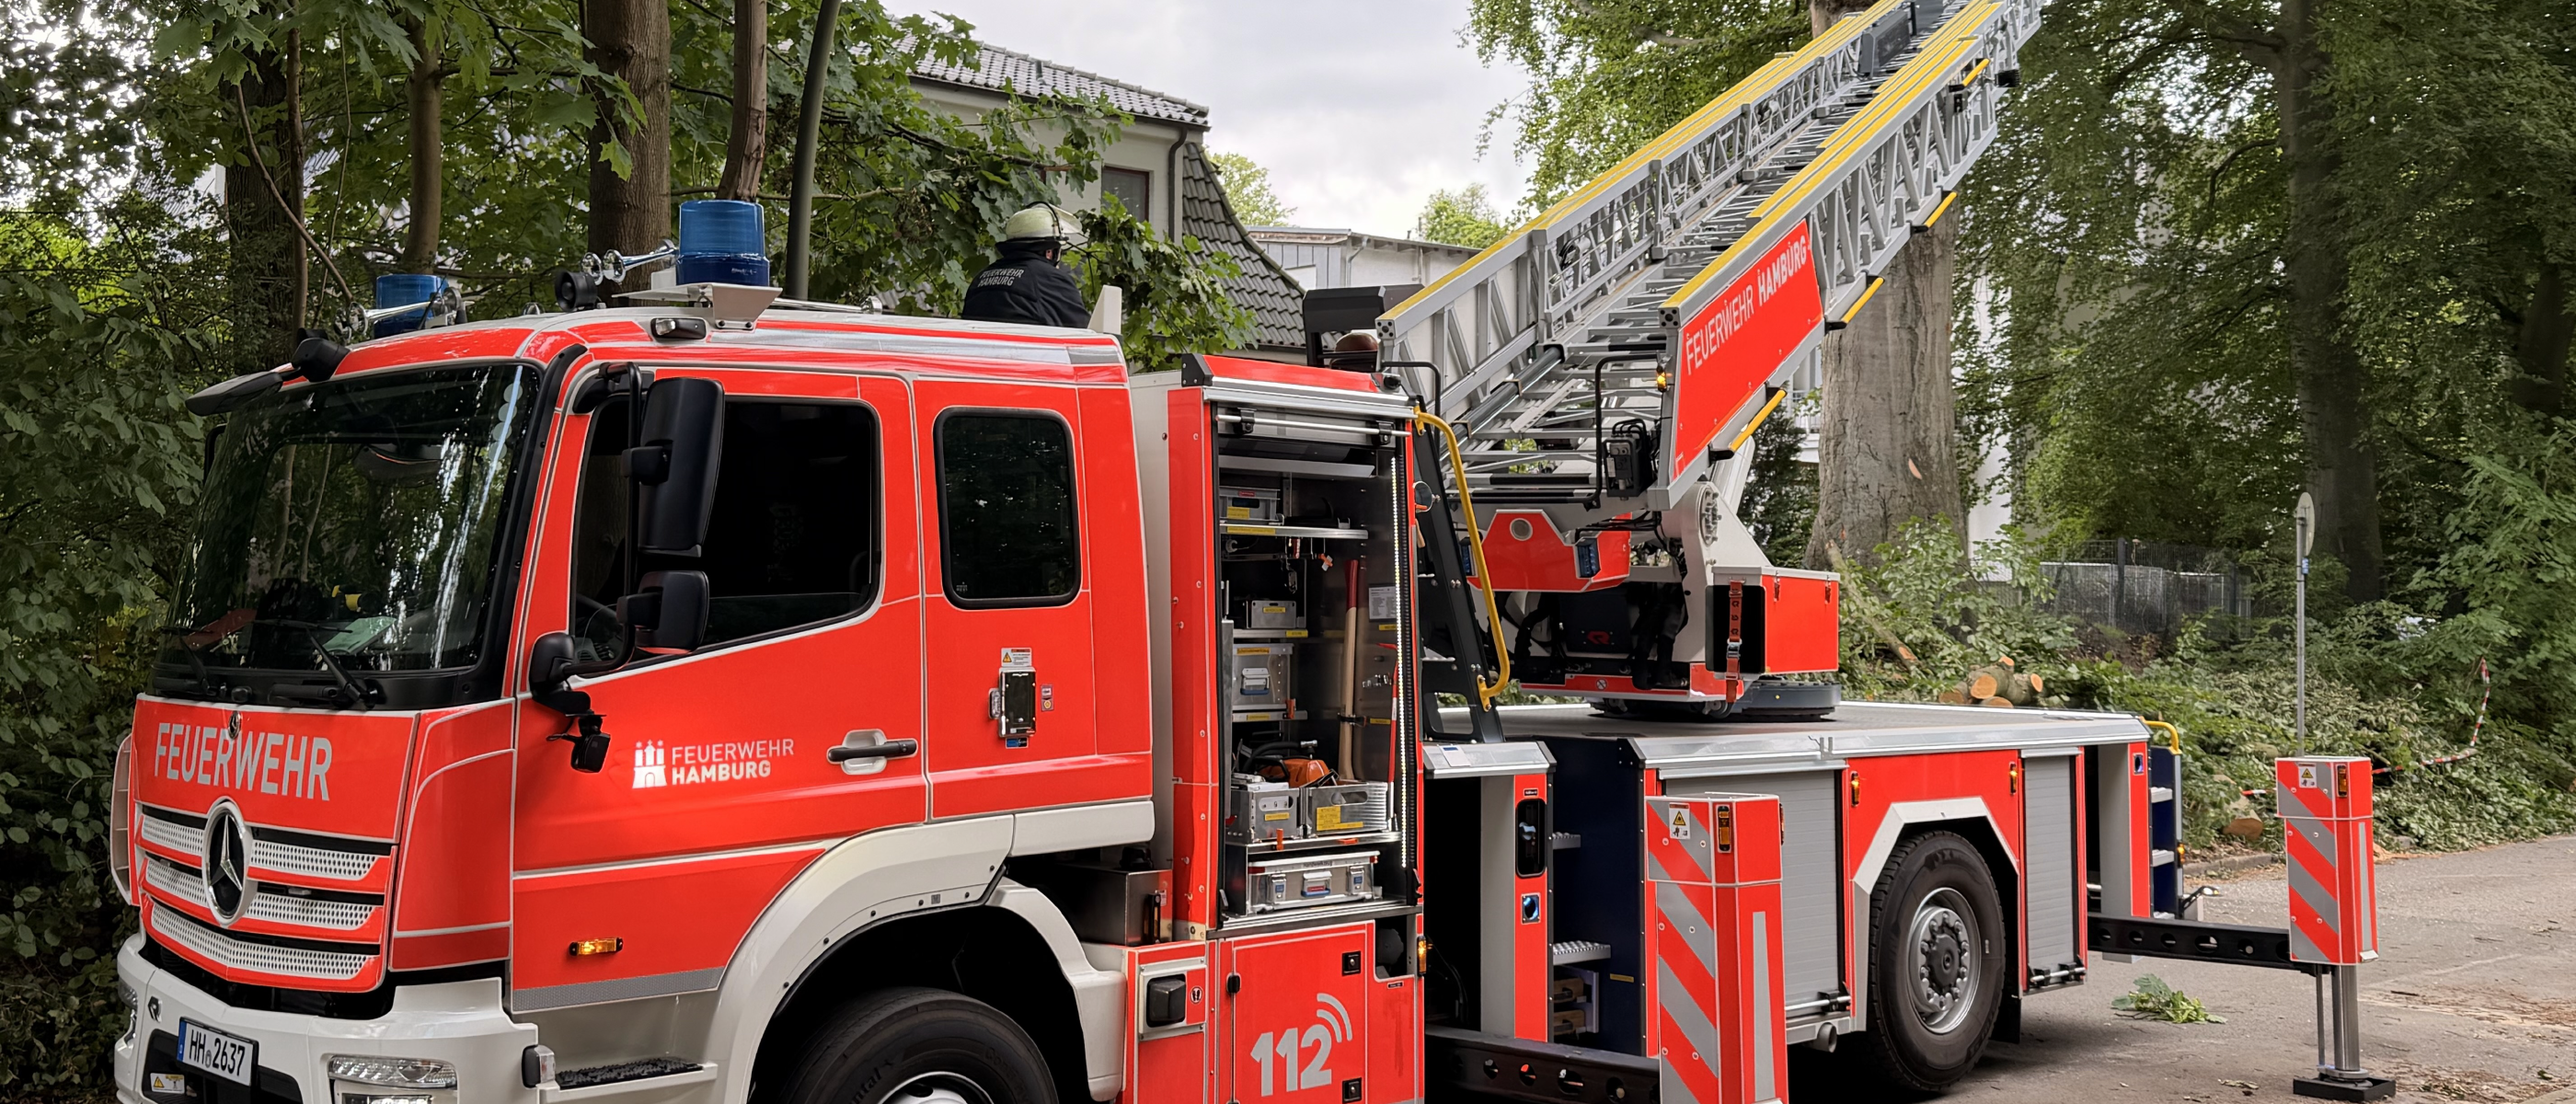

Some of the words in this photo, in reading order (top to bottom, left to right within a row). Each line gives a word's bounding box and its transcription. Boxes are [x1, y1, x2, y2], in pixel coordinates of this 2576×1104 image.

[977, 276, 1015, 288] HAMBURG
[979, 269, 1024, 279] FEUERWEHR
[1685, 284, 1754, 375] FEUERWEHR
[1758, 235, 1807, 306] HAMBURG
[155, 722, 332, 801] FEUERWEHR
[672, 739, 794, 765] FEUERWEHR
[672, 760, 771, 786] HAMBURG
[189, 1029, 207, 1065] HH
[212, 1037, 246, 1076] 2637
[1250, 1024, 1332, 1098] 112
